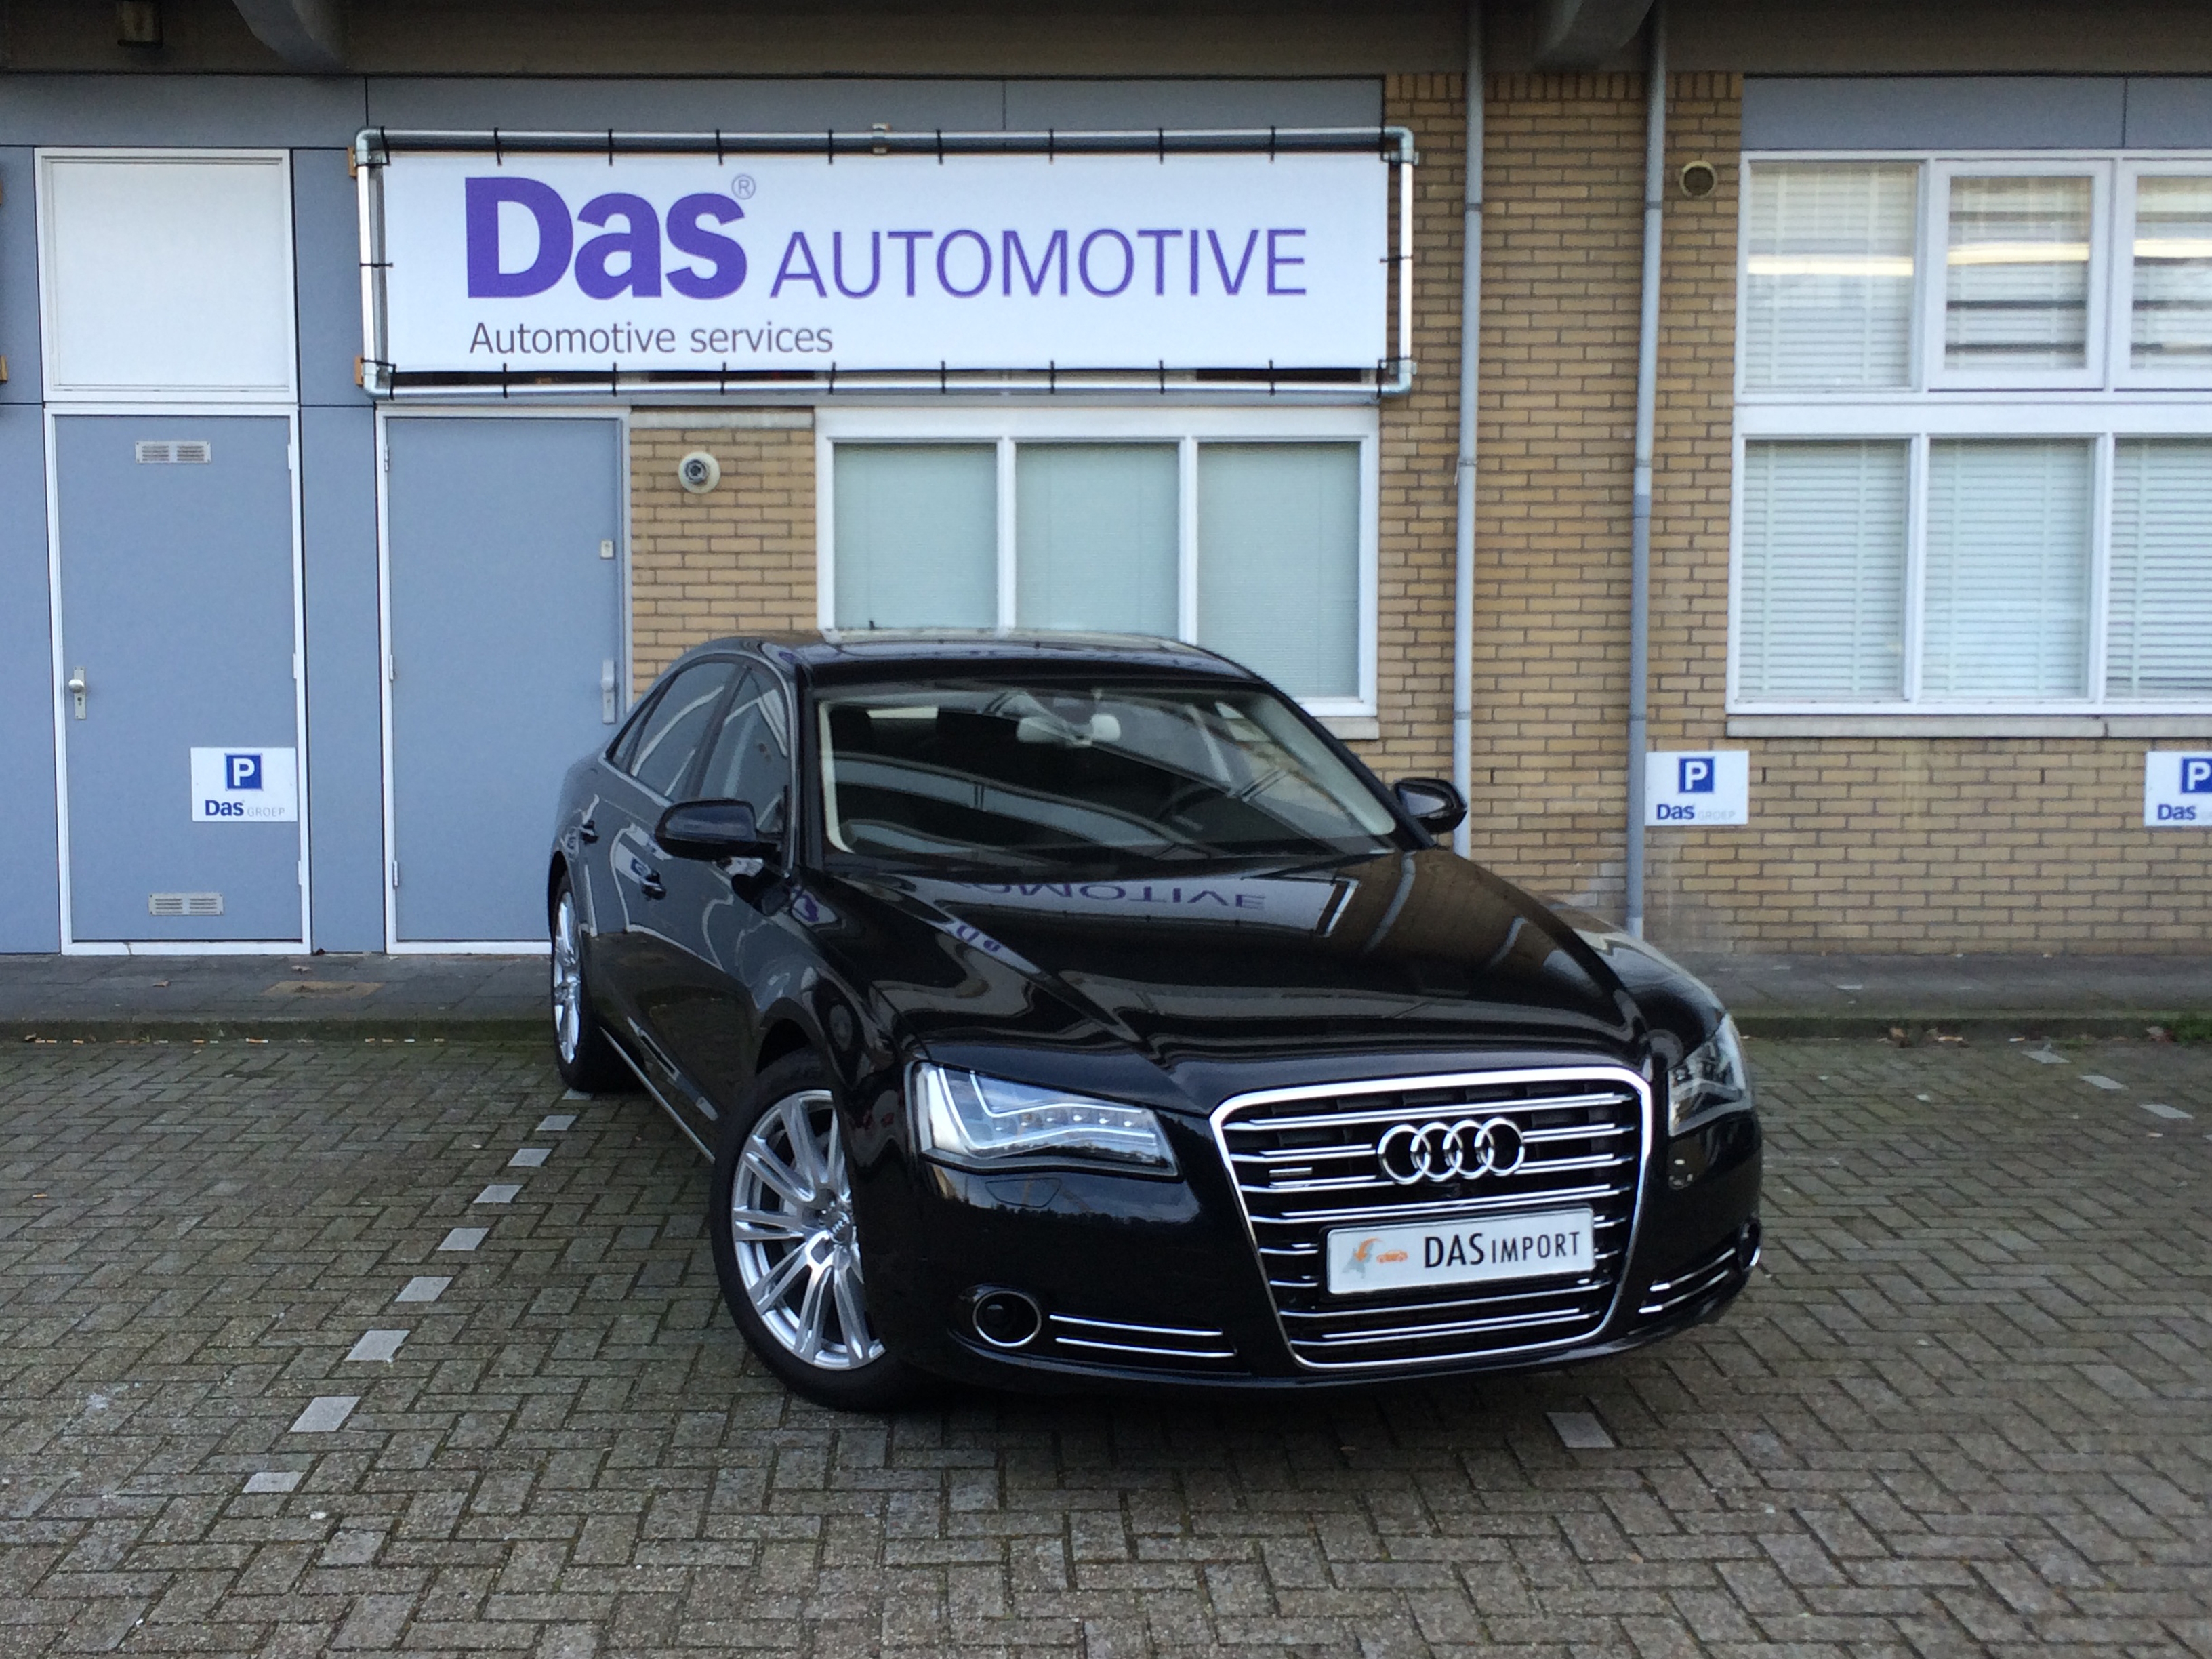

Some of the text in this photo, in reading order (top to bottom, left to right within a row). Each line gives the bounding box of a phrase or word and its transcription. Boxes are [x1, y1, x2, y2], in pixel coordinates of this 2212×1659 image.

[770, 229, 1307, 299] AUTOMOTIVE
[469, 321, 834, 354] Automotive services
[232, 758, 255, 787] P
[1685, 761, 1708, 791] P
[2188, 761, 2211, 791] P
[205, 800, 285, 817] Das GROEP
[1656, 804, 1695, 820] Das
[2157, 804, 2196, 821] Das
[1424, 1231, 1580, 1269] DAS IMPORT
